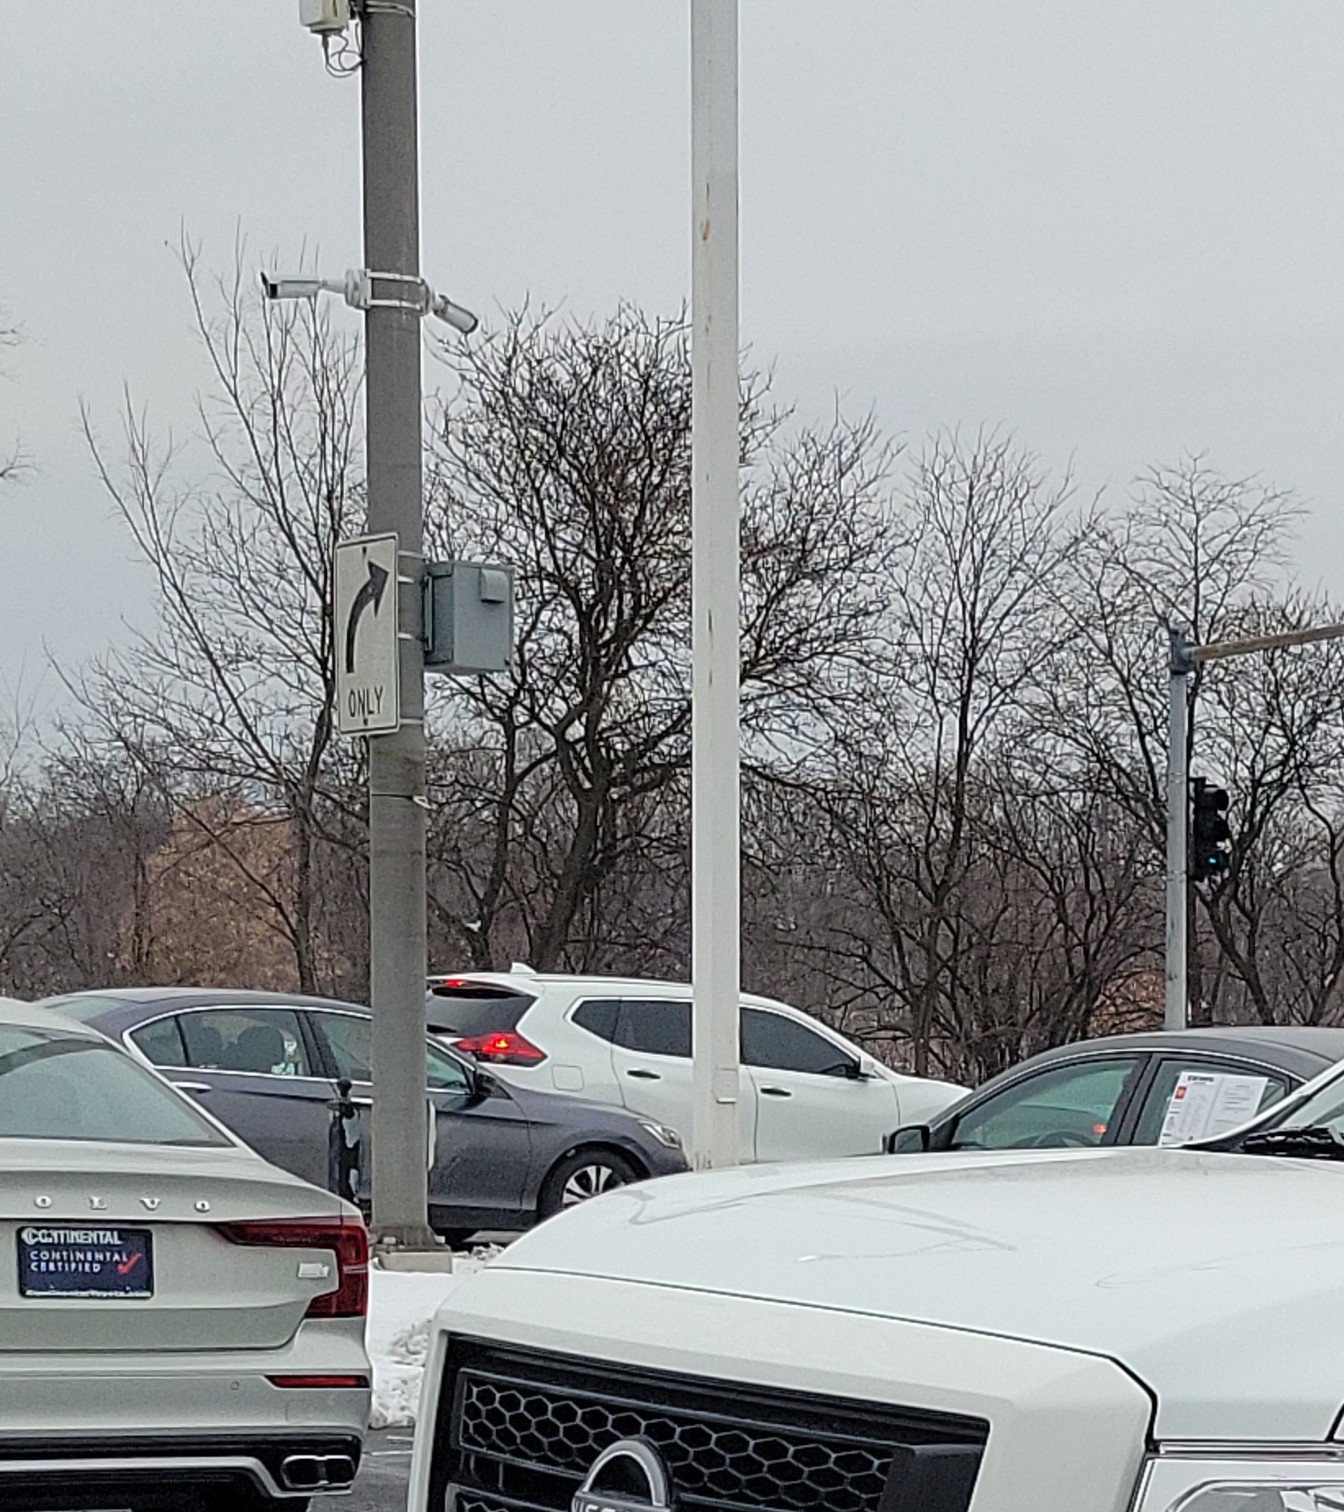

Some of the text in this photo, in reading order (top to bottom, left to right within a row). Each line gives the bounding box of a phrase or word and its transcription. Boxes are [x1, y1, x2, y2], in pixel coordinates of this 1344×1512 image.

[347, 685, 384, 718] ONLY
[30, 1250, 129, 1262] CONTINENTAL
[30, 1261, 101, 1273] CERTIFIED
